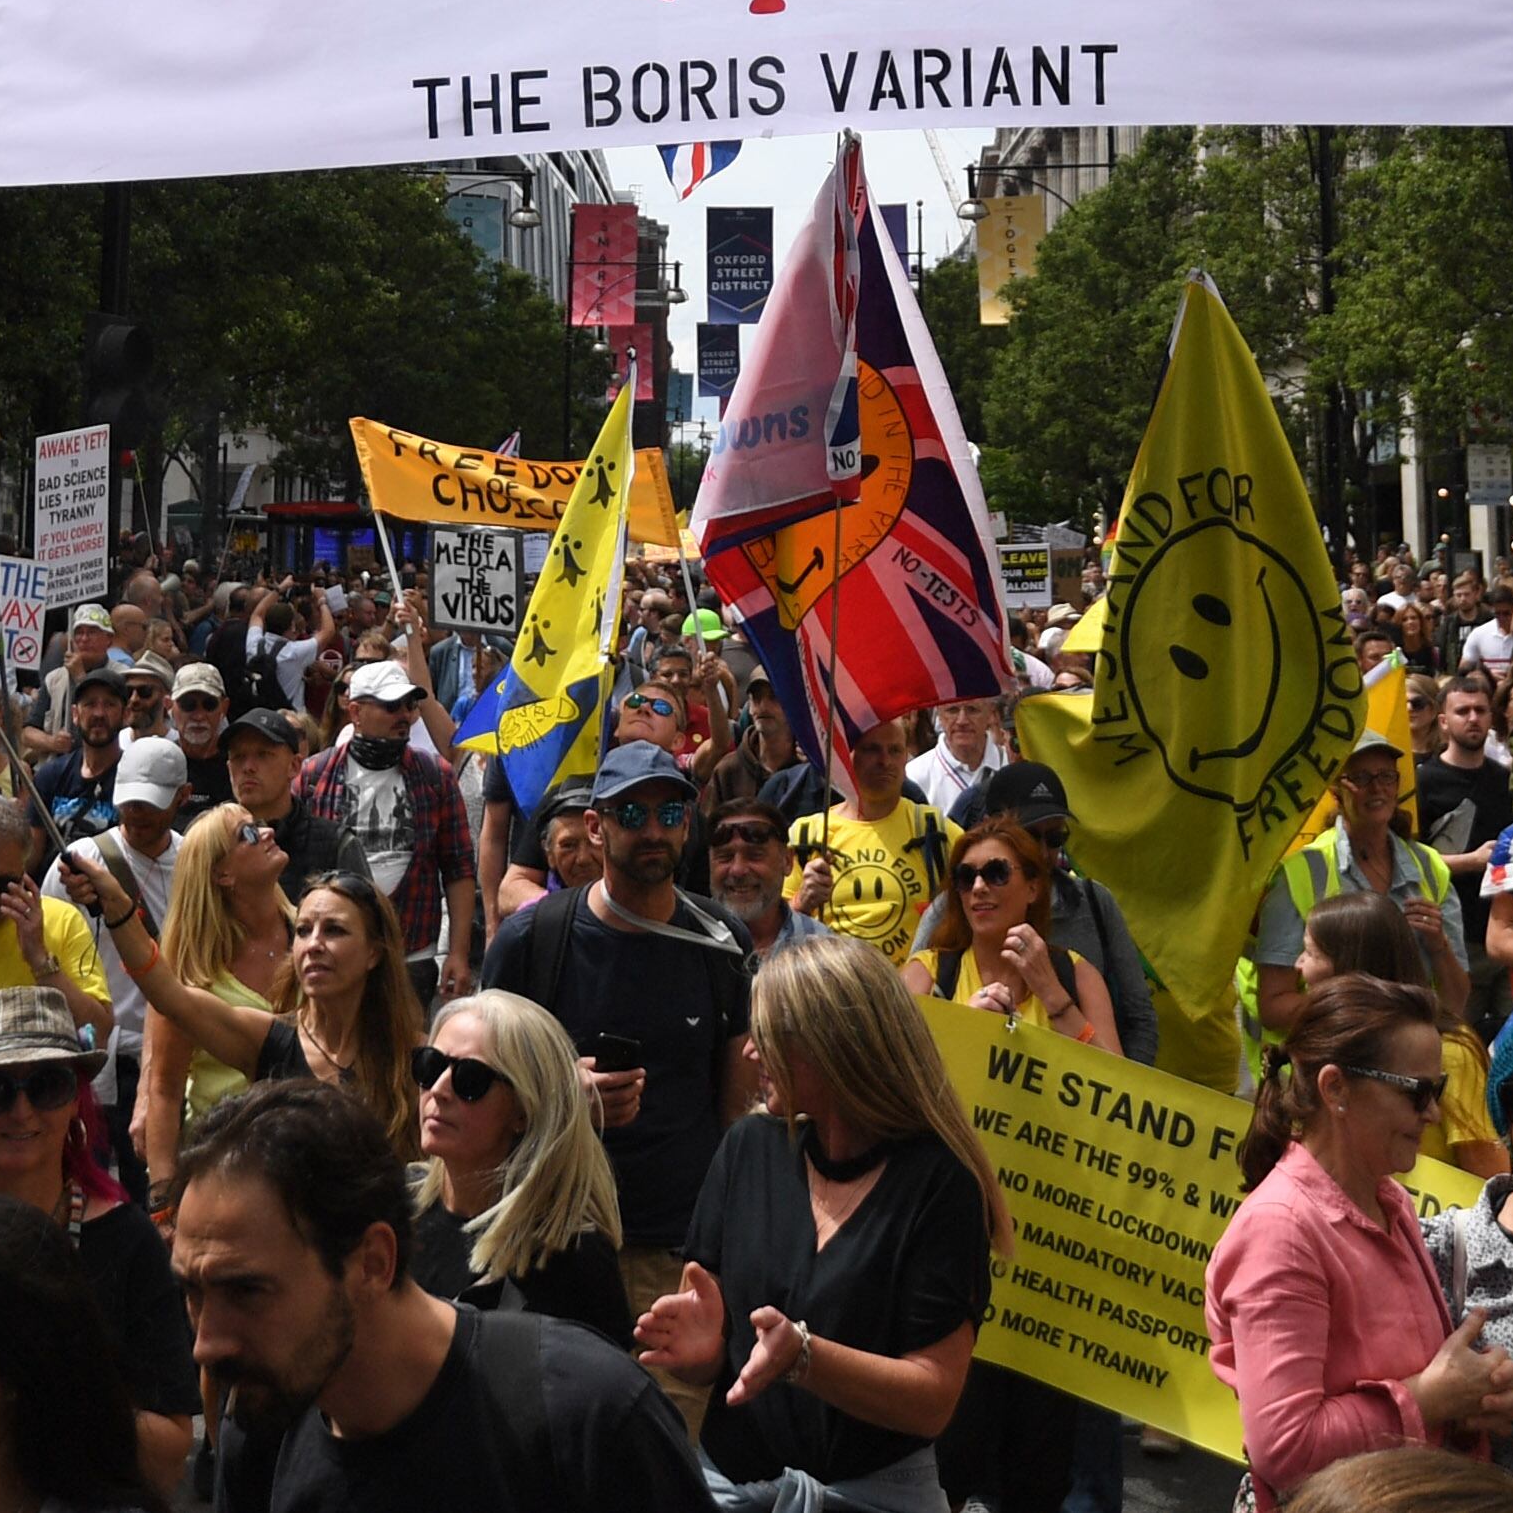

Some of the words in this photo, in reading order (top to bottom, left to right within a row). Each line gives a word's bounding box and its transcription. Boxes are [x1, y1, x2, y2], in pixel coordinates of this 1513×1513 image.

[412, 69, 550, 140] THE
[583, 56, 785, 129] BORIS
[819, 43, 1118, 113] VARIANT
[714, 254, 766, 265] OXFORD
[717, 267, 764, 278] STREET
[711, 280, 770, 291] DISTRICT
[39, 433, 81, 460] AWAKE
[83, 430, 108, 452] YET?
[71, 459, 79, 468] TO
[387, 429, 583, 490] FREEDO
[38, 475, 61, 492] BAD
[64, 466, 106, 487] SCIENCE
[883, 454, 909, 500] THE
[39, 493, 61, 510] LIES
[73, 484, 106, 505] FRAUD
[1178, 467, 1256, 523] FOR
[50, 502, 95, 525] TYRANNY
[40, 533, 47, 547] IF
[51, 530, 68, 545] YOU
[70, 522, 104, 540] COMPLY
[456, 532, 495, 551] THE
[38, 548, 46, 561] IT
[48, 544, 71, 560] GETS
[436, 541, 513, 571] MEDIA
[1001, 551, 1048, 564] LEAVE
[47, 578, 72, 591] NTROL
[81, 568, 104, 584] PROFIT
[55, 563, 78, 578] ABOUT
[79, 557, 103, 573] POWER
[469, 565, 486, 582] IS
[1001, 568, 1024, 578] OUR
[0, 562, 48, 601] THE
[456, 577, 492, 596] THE
[1006, 581, 1046, 592] ALONE
[55, 590, 77, 605] ABOUT
[441, 593, 515, 625] VIRUS
[1091, 690, 1151, 767] WE
[1235, 605, 1364, 862] FREEDOM
[891, 857, 921, 896] FOR
[987, 1044, 1048, 1095] WE
[1058, 1071, 1195, 1148] STAND
[973, 1105, 1012, 1136] WE
[1014, 1120, 1068, 1157] ARE
[1073, 1138, 1122, 1177] THE
[1127, 1160, 1176, 1199] 99%
[1183, 1183, 1200, 1208] &
[997, 1167, 1029, 1193] NO
[1032, 1179, 1094, 1218] MORE
[1096, 1203, 1215, 1263] LOCKDOWN
[1022, 1222, 1157, 1288] MANDATORY
[1011, 1265, 1094, 1313] HEALTH
[1097, 1298, 1213, 1357] PASSPORT
[1000, 1308, 1064, 1348] MORE
[1068, 1333, 1169, 1389] TYRANNY
